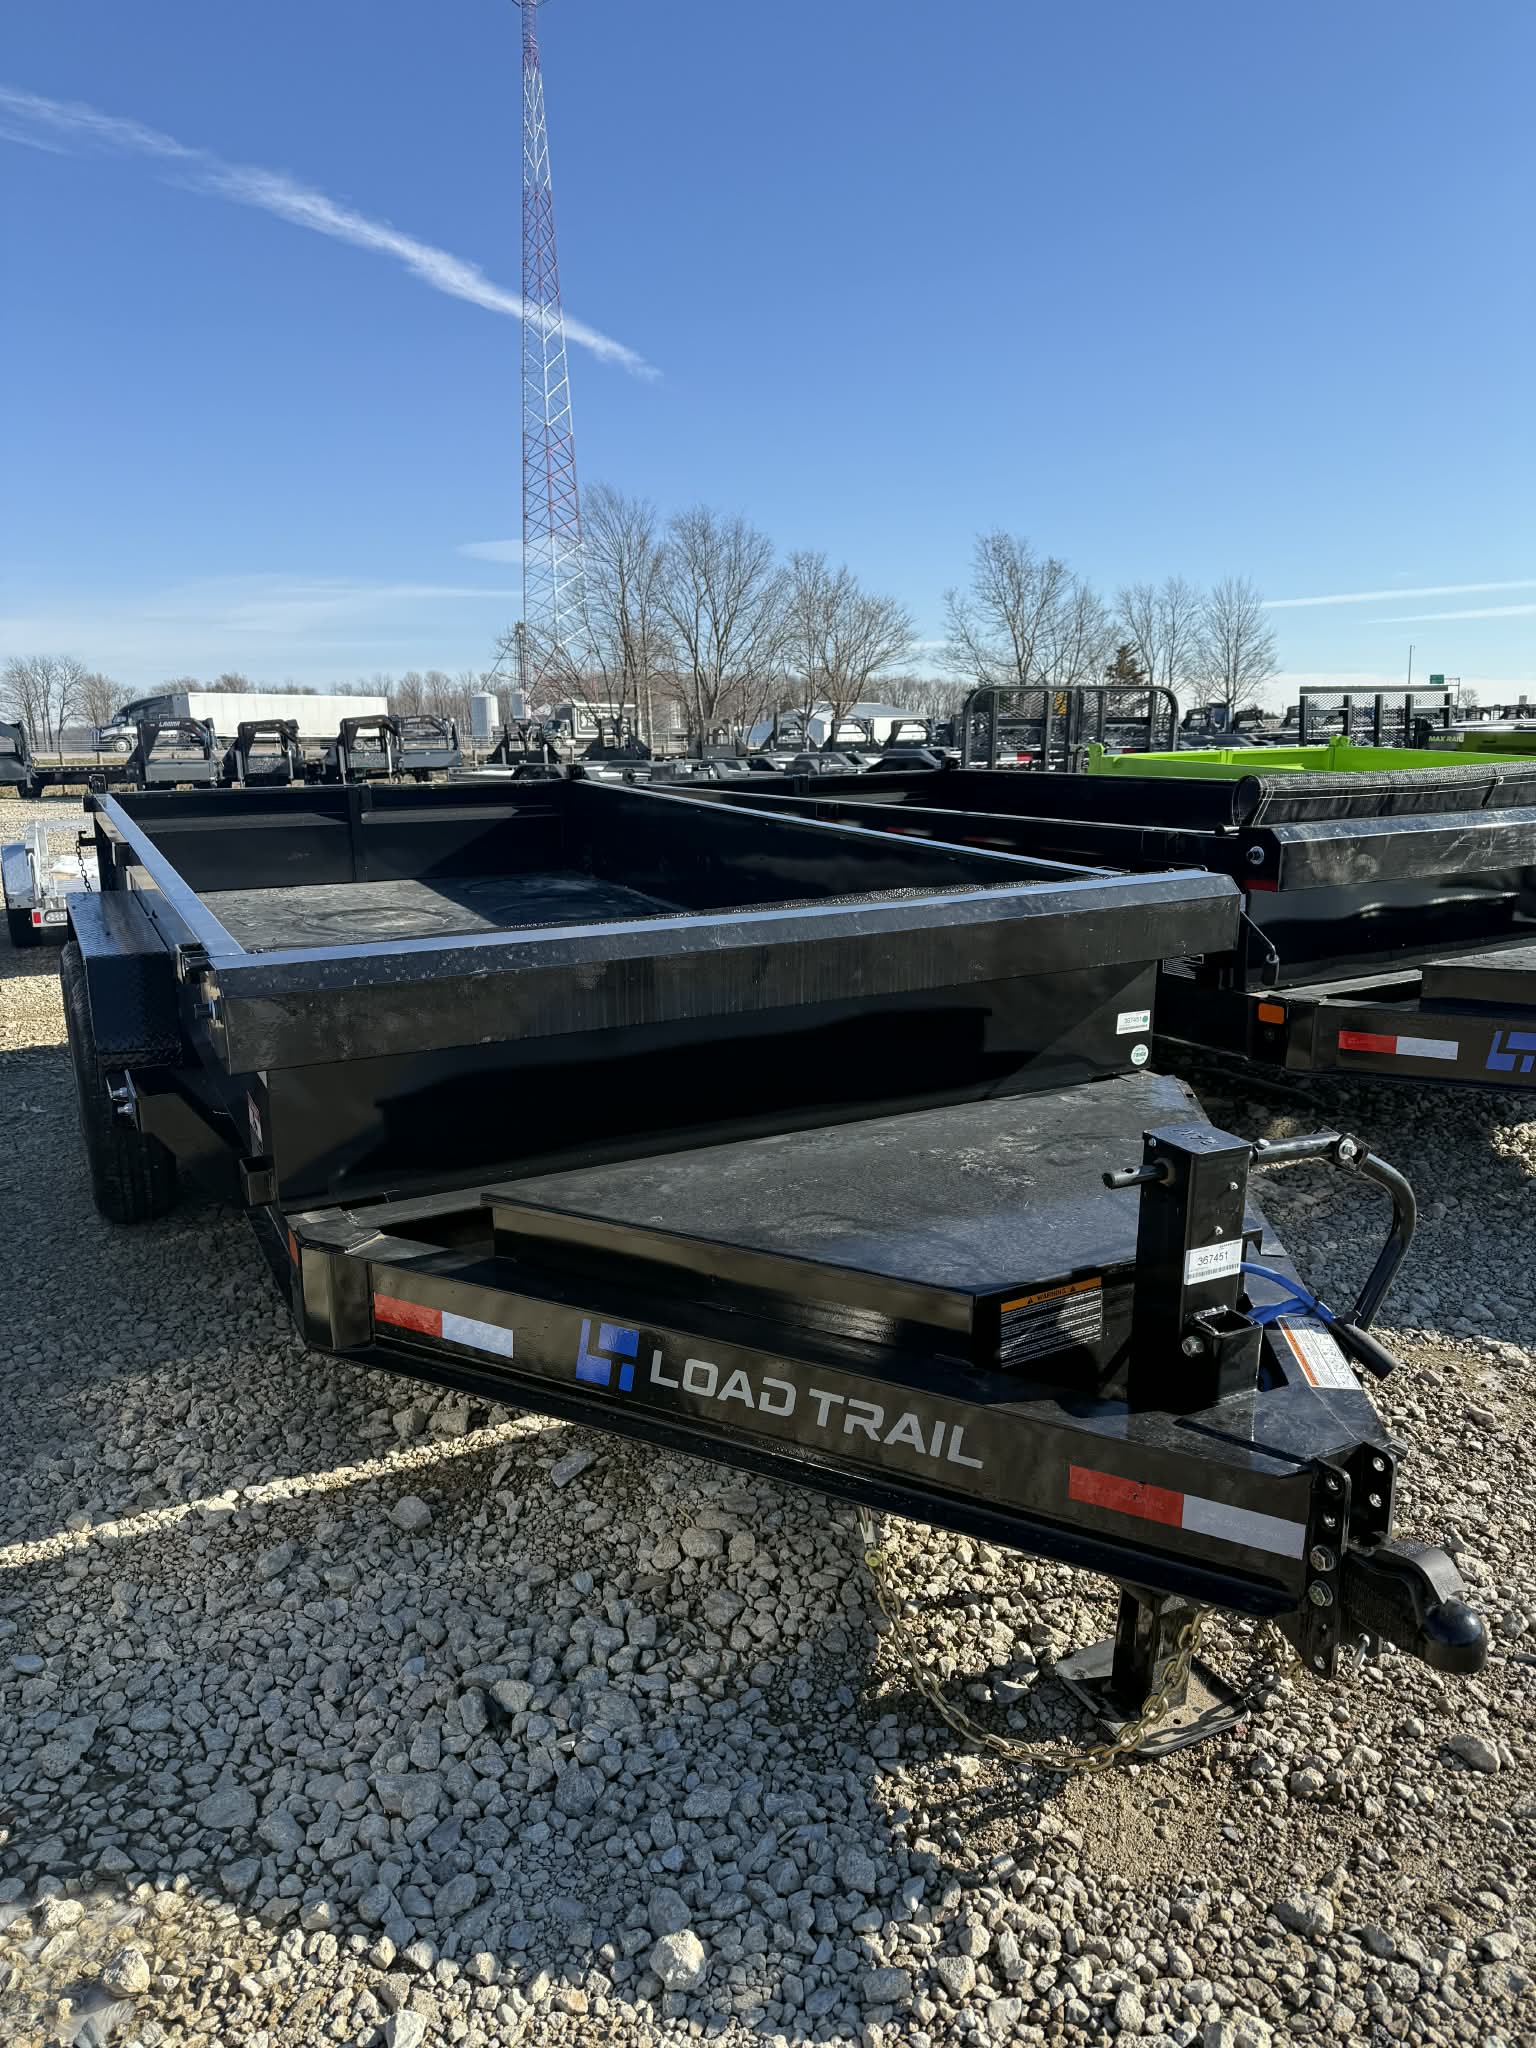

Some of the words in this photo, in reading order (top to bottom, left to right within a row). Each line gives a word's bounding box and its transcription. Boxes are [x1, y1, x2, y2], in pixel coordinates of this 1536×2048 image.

[1197, 1251, 1228, 1266] 367451
[649, 1350, 797, 1417] LOAD
[808, 1388, 984, 1470] TRAIL
